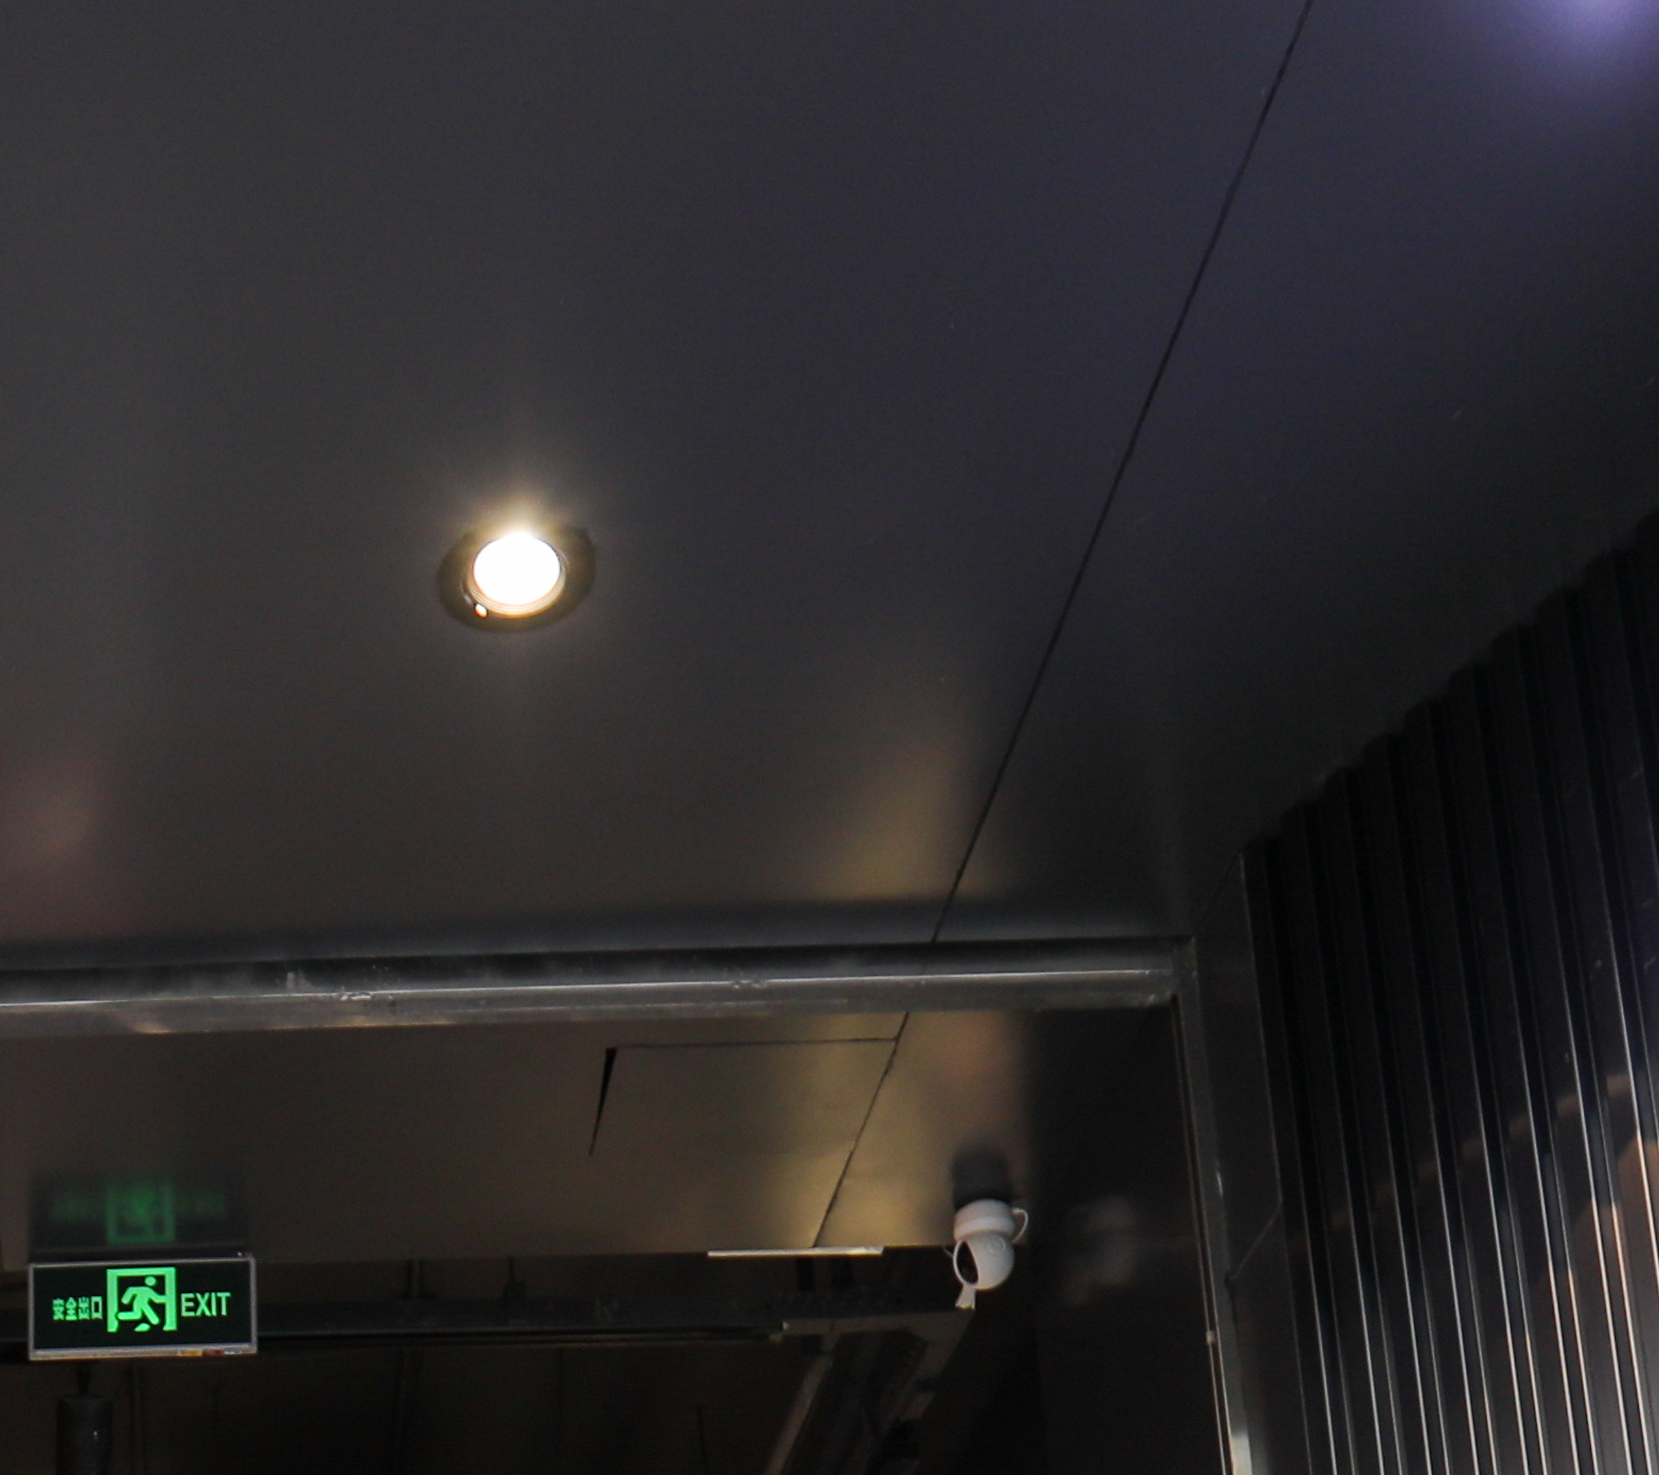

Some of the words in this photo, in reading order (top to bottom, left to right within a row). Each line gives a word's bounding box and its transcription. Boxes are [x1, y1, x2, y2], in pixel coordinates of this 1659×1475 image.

[52, 1295, 103, 1321] 安全出口
[180, 1291, 231, 1317] EXIT
